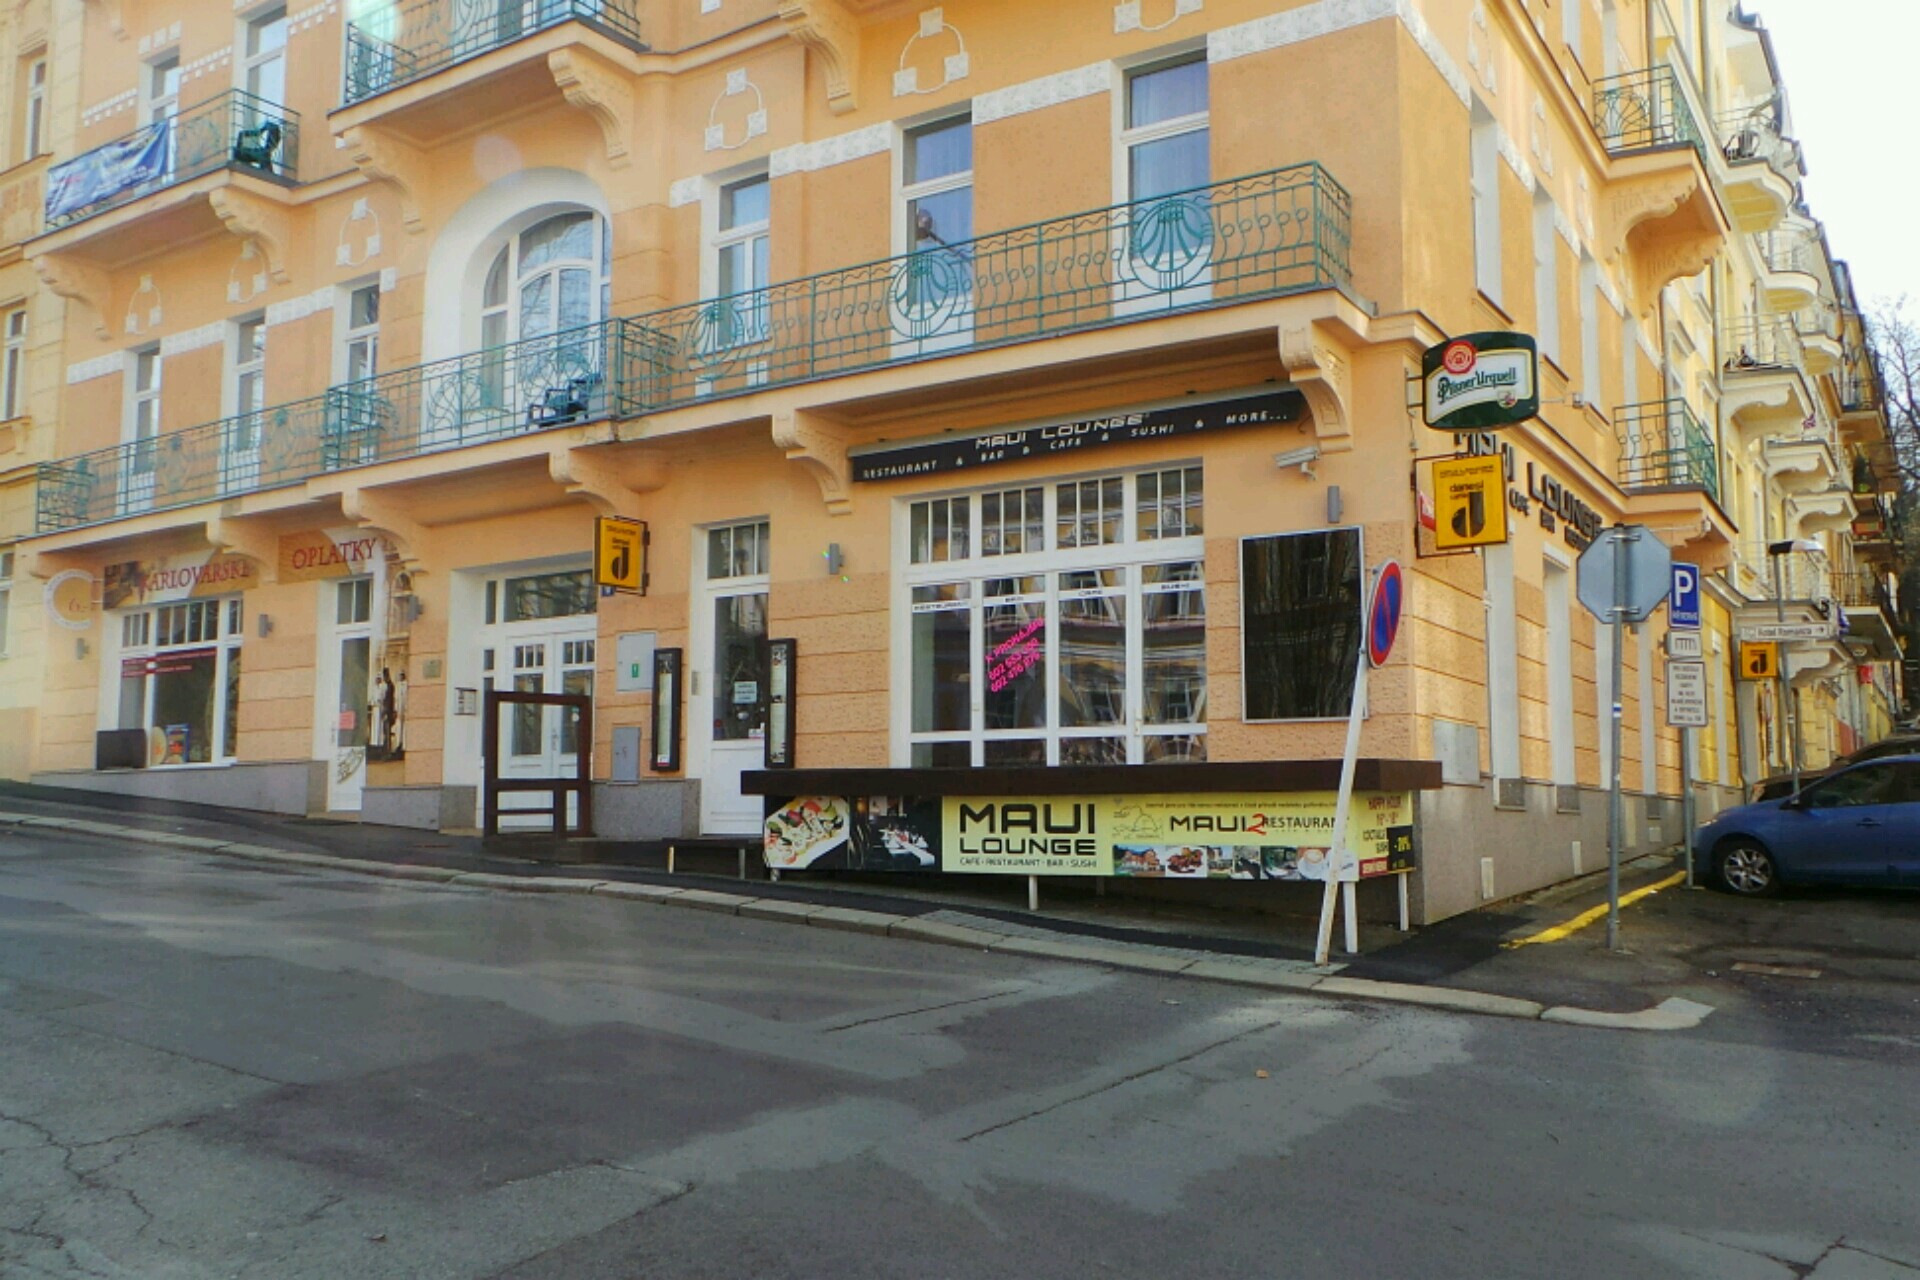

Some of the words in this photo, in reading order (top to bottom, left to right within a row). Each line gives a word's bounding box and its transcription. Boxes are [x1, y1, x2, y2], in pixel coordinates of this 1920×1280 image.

[976, 432, 1026, 449] MAUI
[1041, 414, 1143, 439] LOUNGE
[863, 460, 937, 479] RESTAURANT
[981, 450, 1004, 462] BAR
[1131, 424, 1174, 437] SUSHI
[292, 538, 376, 569] OPLATKY
[1675, 570, 1694, 607] P
[960, 804, 1095, 834] MAUI
[960, 837, 1097, 856] LOUNGE
